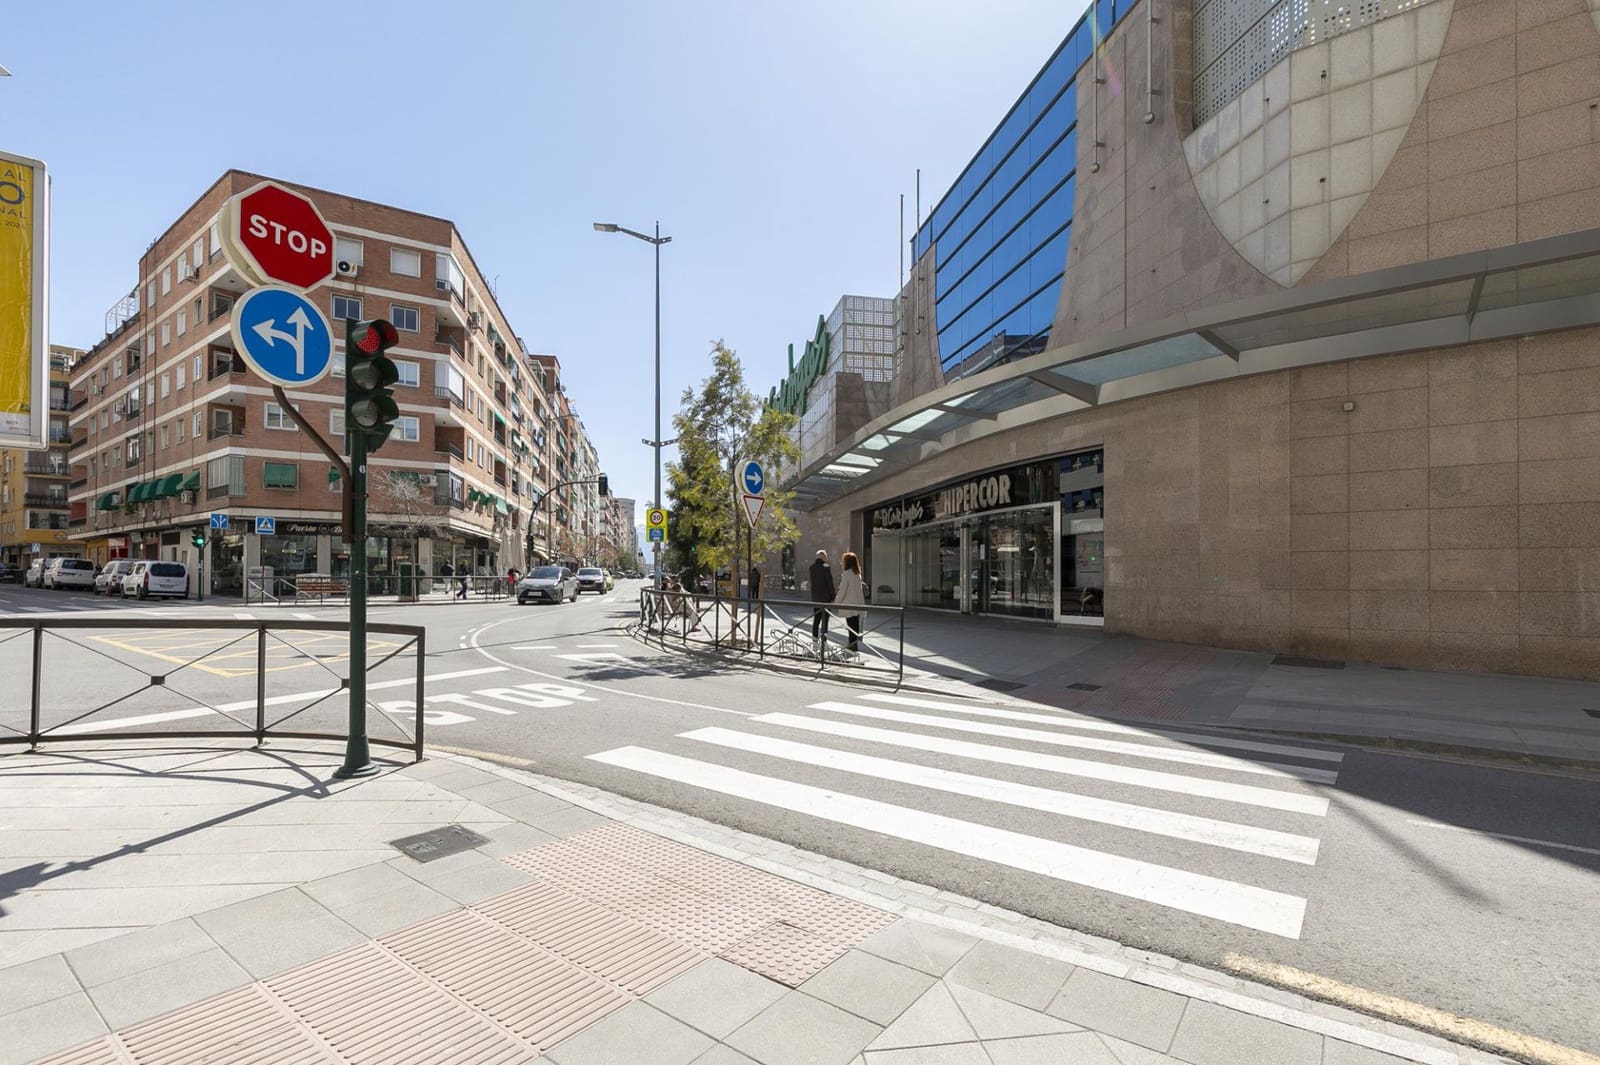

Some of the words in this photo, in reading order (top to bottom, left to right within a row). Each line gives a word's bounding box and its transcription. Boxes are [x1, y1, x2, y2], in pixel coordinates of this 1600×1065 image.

[249, 213, 327, 259] STOP
[943, 474, 1011, 514] HIPERCOR
[375, 682, 599, 726] STOP
